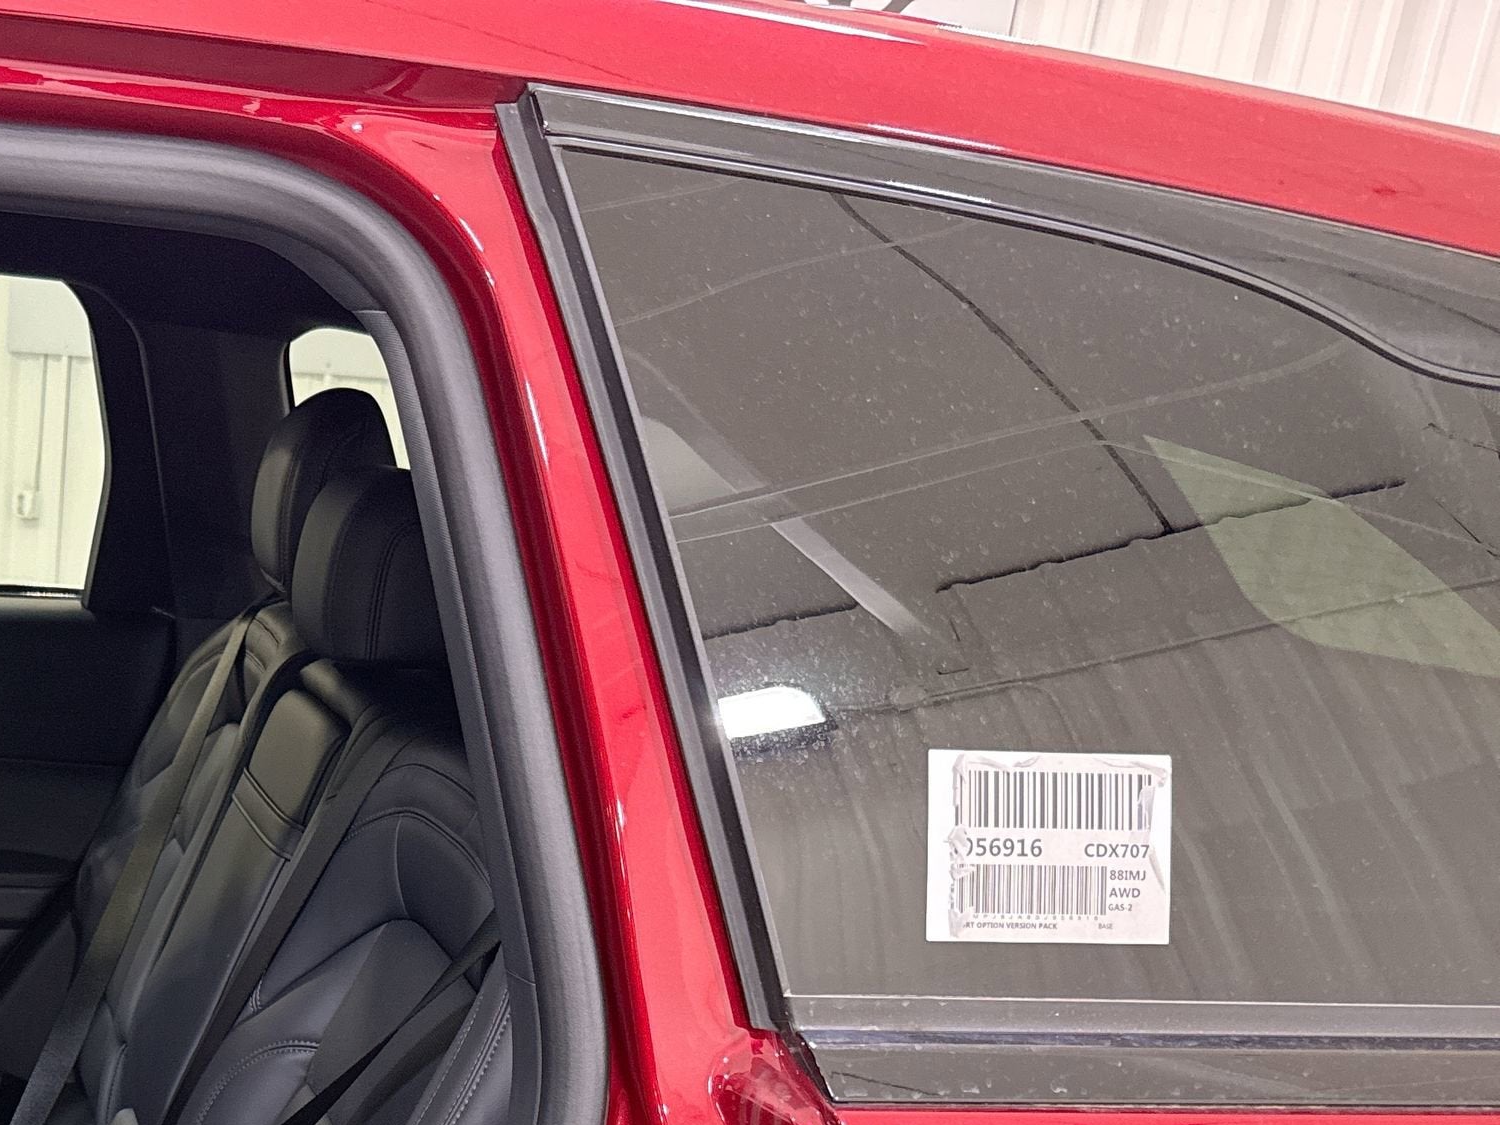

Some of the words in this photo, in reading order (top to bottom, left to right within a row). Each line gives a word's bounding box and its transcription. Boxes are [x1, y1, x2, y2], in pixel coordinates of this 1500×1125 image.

[1084, 843, 1150, 859] CDX707
[1109, 869, 1147, 882] 88IMJ
[1108, 887, 1141, 899] AWD
[977, 921, 1005, 929] OPTION
[1006, 922, 1037, 930] VERSION
[1038, 922, 1058, 930] PACK
[1098, 922, 1114, 930] BASE
